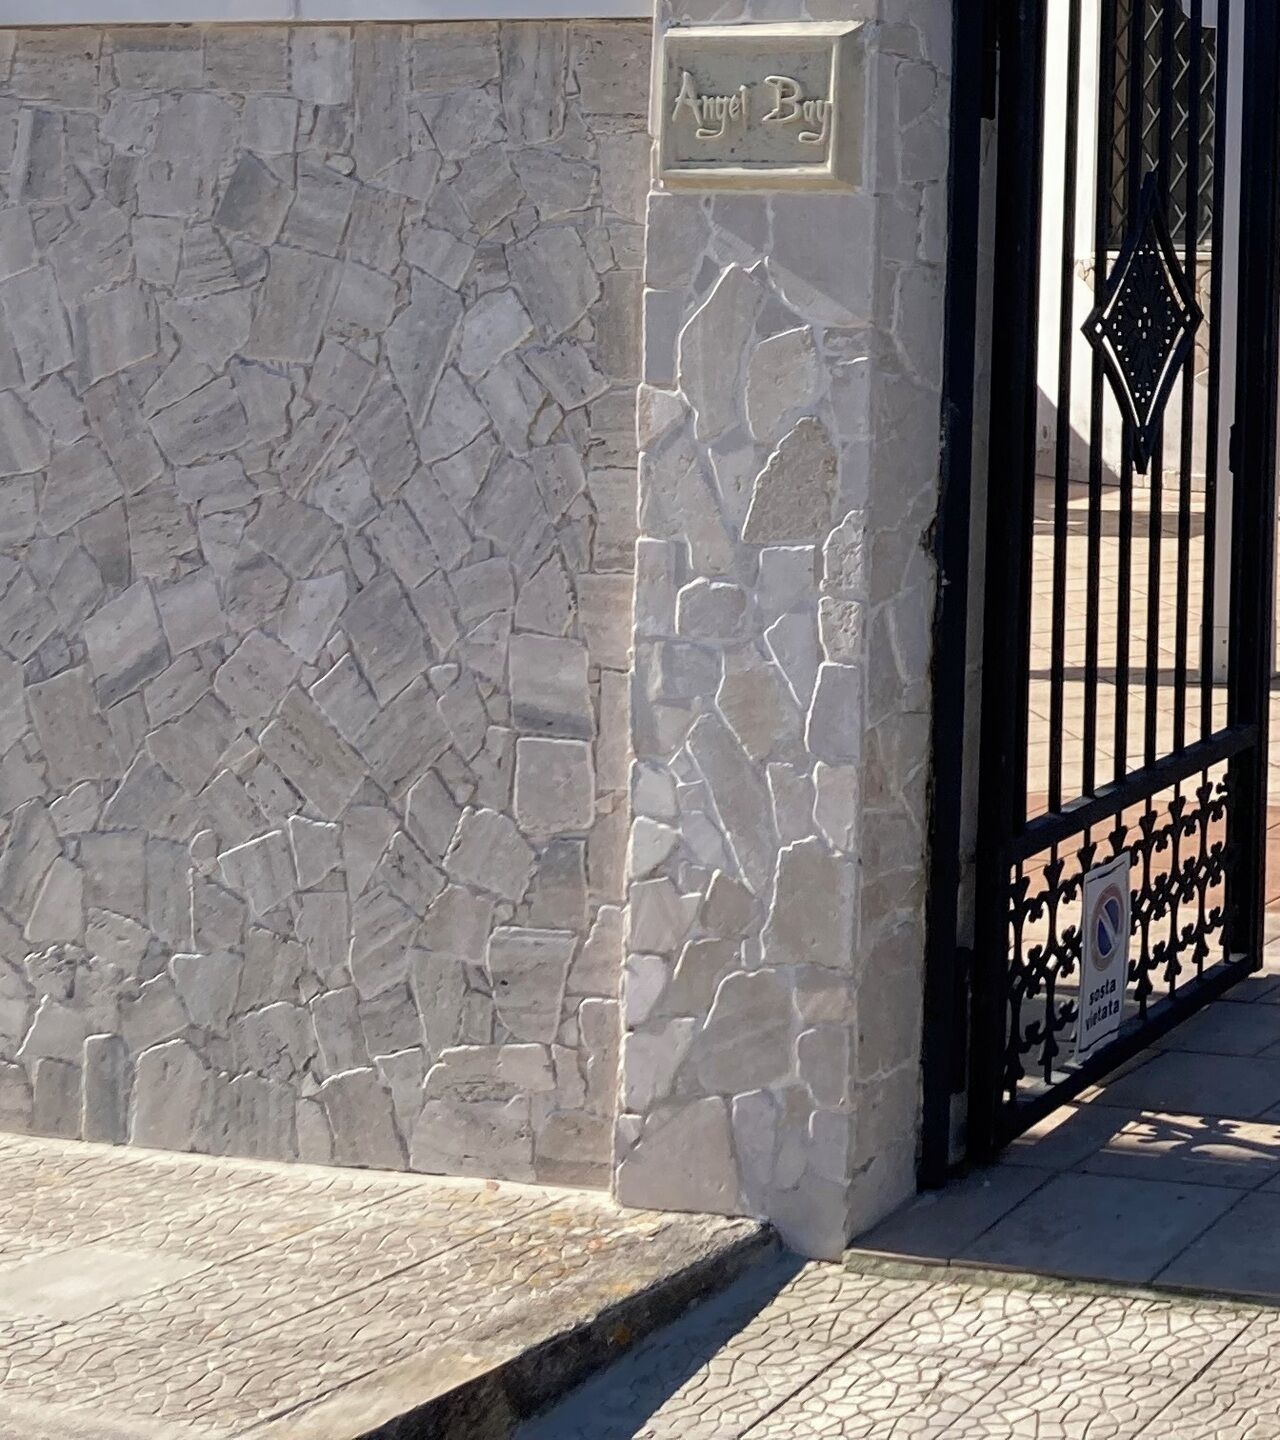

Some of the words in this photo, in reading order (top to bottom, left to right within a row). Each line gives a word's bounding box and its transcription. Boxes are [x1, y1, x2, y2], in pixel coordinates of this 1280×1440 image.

[672, 71, 747, 140] Angel
[762, 75, 833, 144] Bay
[1088, 978, 1117, 1004] sosta
[1085, 999, 1120, 1032] vietata
